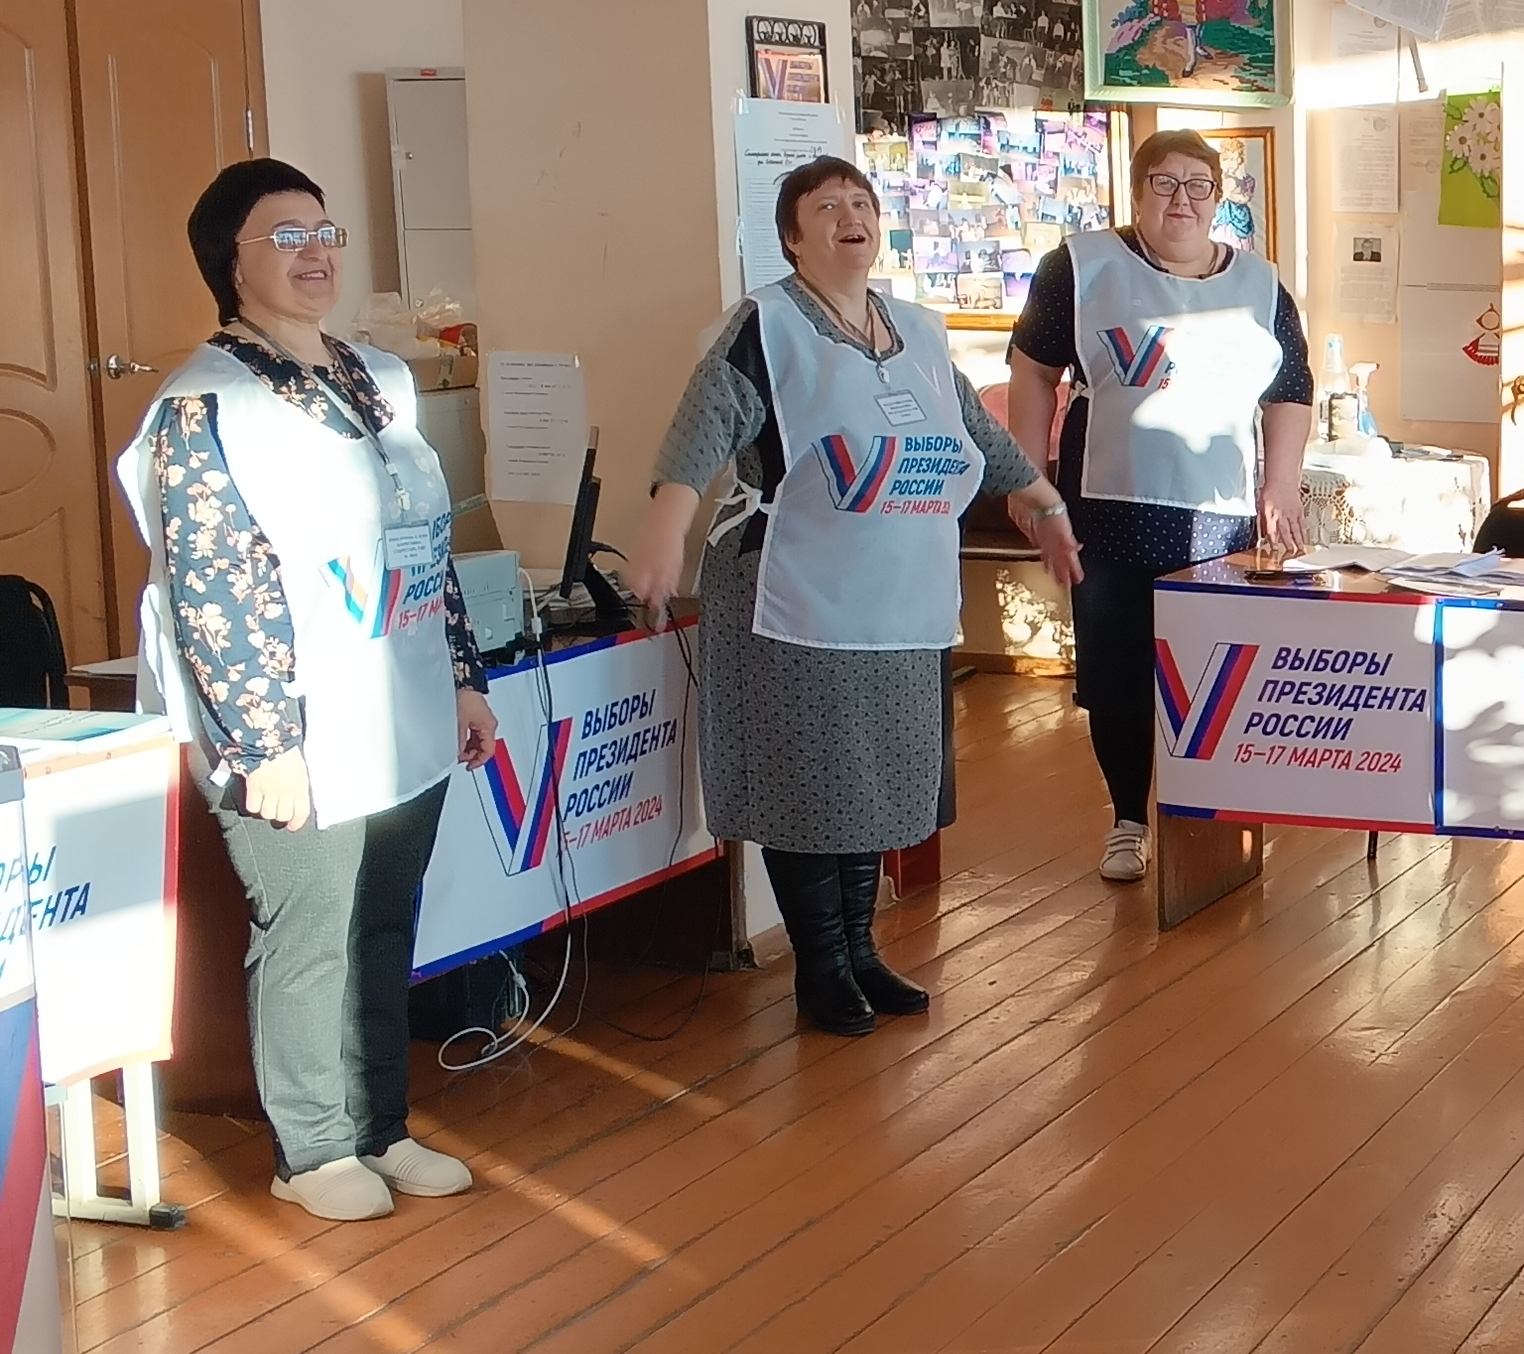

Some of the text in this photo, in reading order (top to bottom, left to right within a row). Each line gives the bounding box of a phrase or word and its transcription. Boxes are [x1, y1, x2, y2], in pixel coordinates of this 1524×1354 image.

[904, 436, 963, 454] ВЫБОРЫ
[889, 479, 945, 496] РОССИИ
[1271, 646, 1393, 676] ВЫБОРЫ
[1257, 679, 1428, 713] ПРЕЗИДЕНТА
[581, 688, 656, 740] ВЫБОРЫ
[1243, 711, 1354, 741] РОССИИ
[572, 718, 677, 782] ПРЕЗИДЕНТА
[1286, 746, 1353, 771] МАРТА
[1354, 751, 1403, 773] 2024
[563, 770, 634, 821] РОССИИ
[592, 807, 633, 843] МАРТА
[633, 794, 663, 827] 2024
